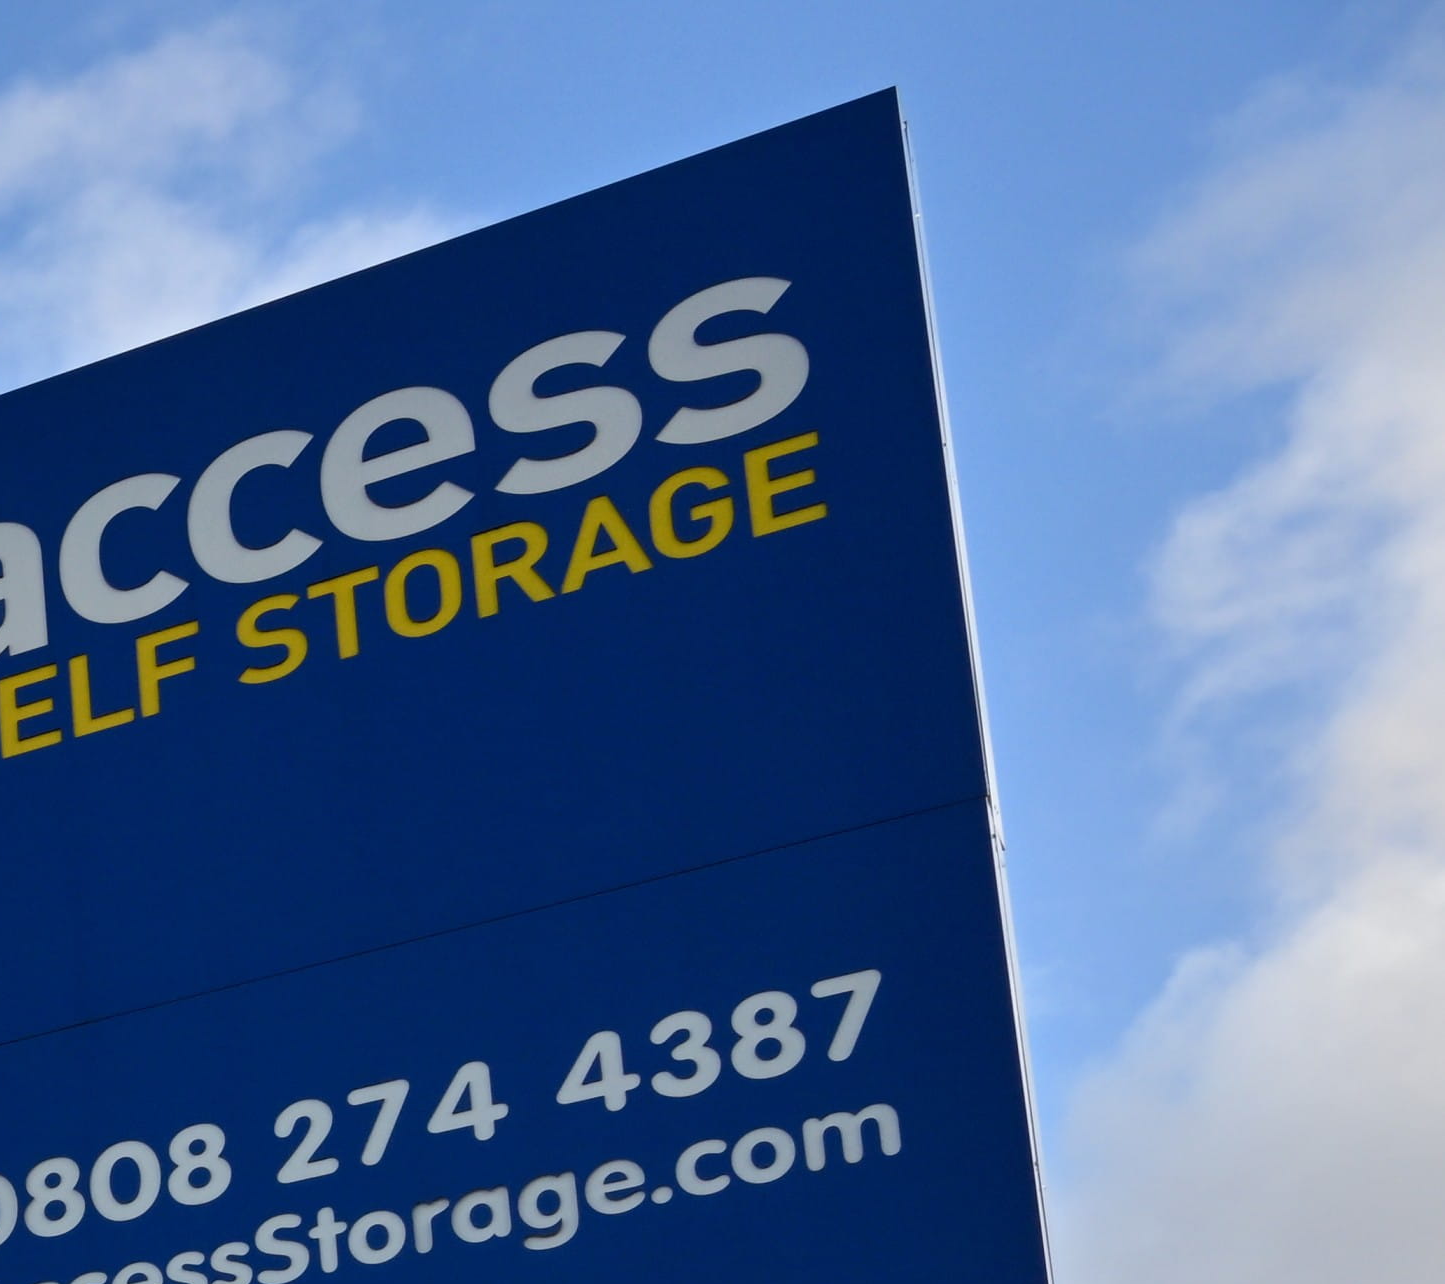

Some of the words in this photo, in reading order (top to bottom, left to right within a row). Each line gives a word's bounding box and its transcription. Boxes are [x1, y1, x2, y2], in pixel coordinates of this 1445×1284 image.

[237, 430, 829, 685] STORAGE
[274, 1060, 510, 1184] 274
[555, 968, 883, 1111] 4387
